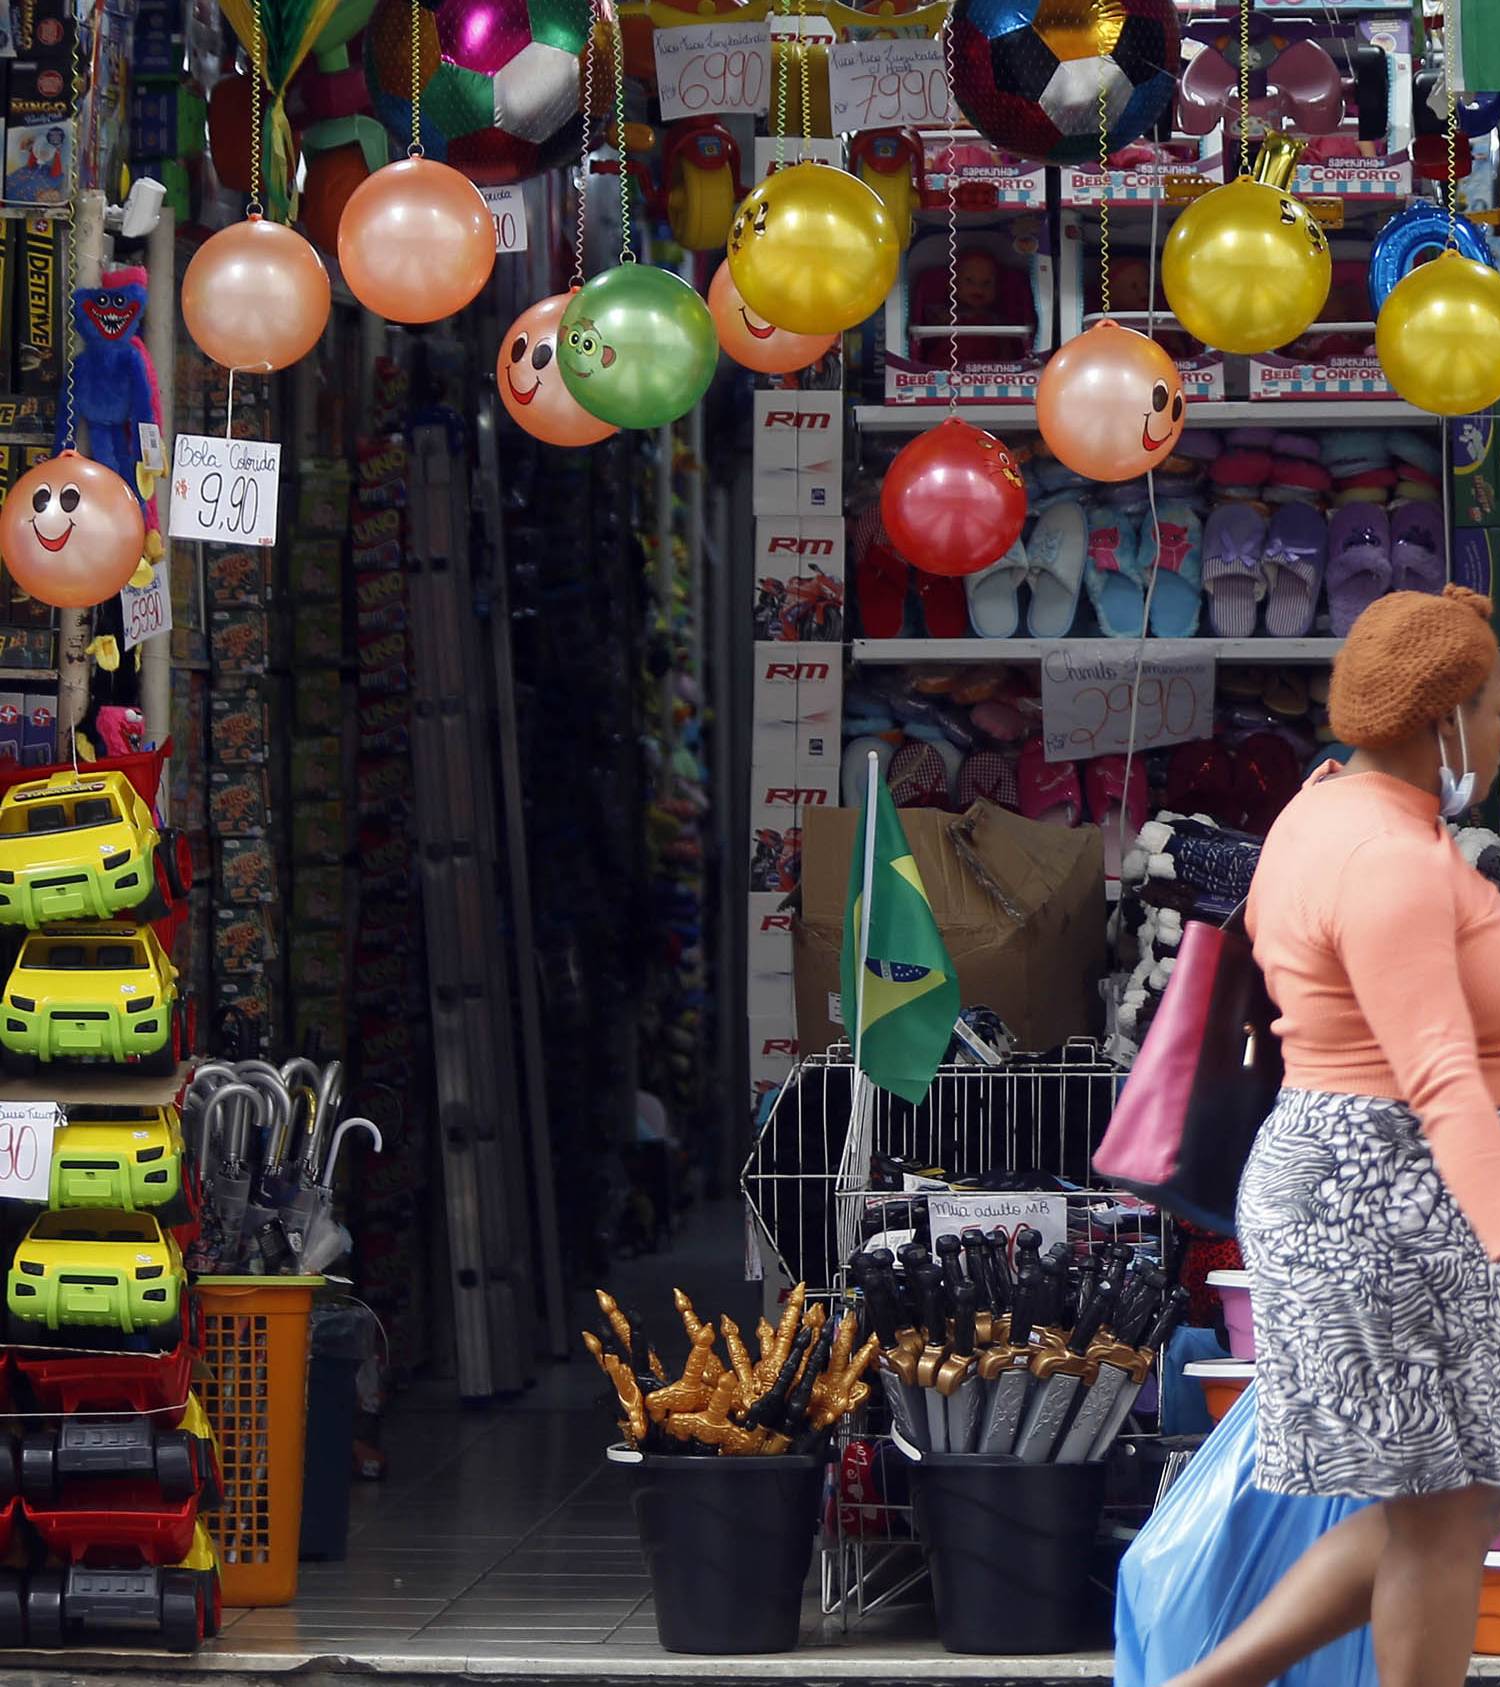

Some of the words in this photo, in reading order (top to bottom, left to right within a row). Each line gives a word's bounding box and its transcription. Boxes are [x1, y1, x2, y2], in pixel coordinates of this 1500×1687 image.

[1310, 167, 1402, 182] CONFORTO
[27, 252, 53, 347] DETETIVE
[946, 372, 1038, 388] CONFORTO
[764, 410, 831, 430] RM
[178, 437, 222, 468] Bola
[198, 472, 258, 535] 9,90
[767, 536, 834, 556] RM
[765, 662, 830, 680] RM
[764, 787, 828, 805] RM
[760, 914, 792, 931] R
